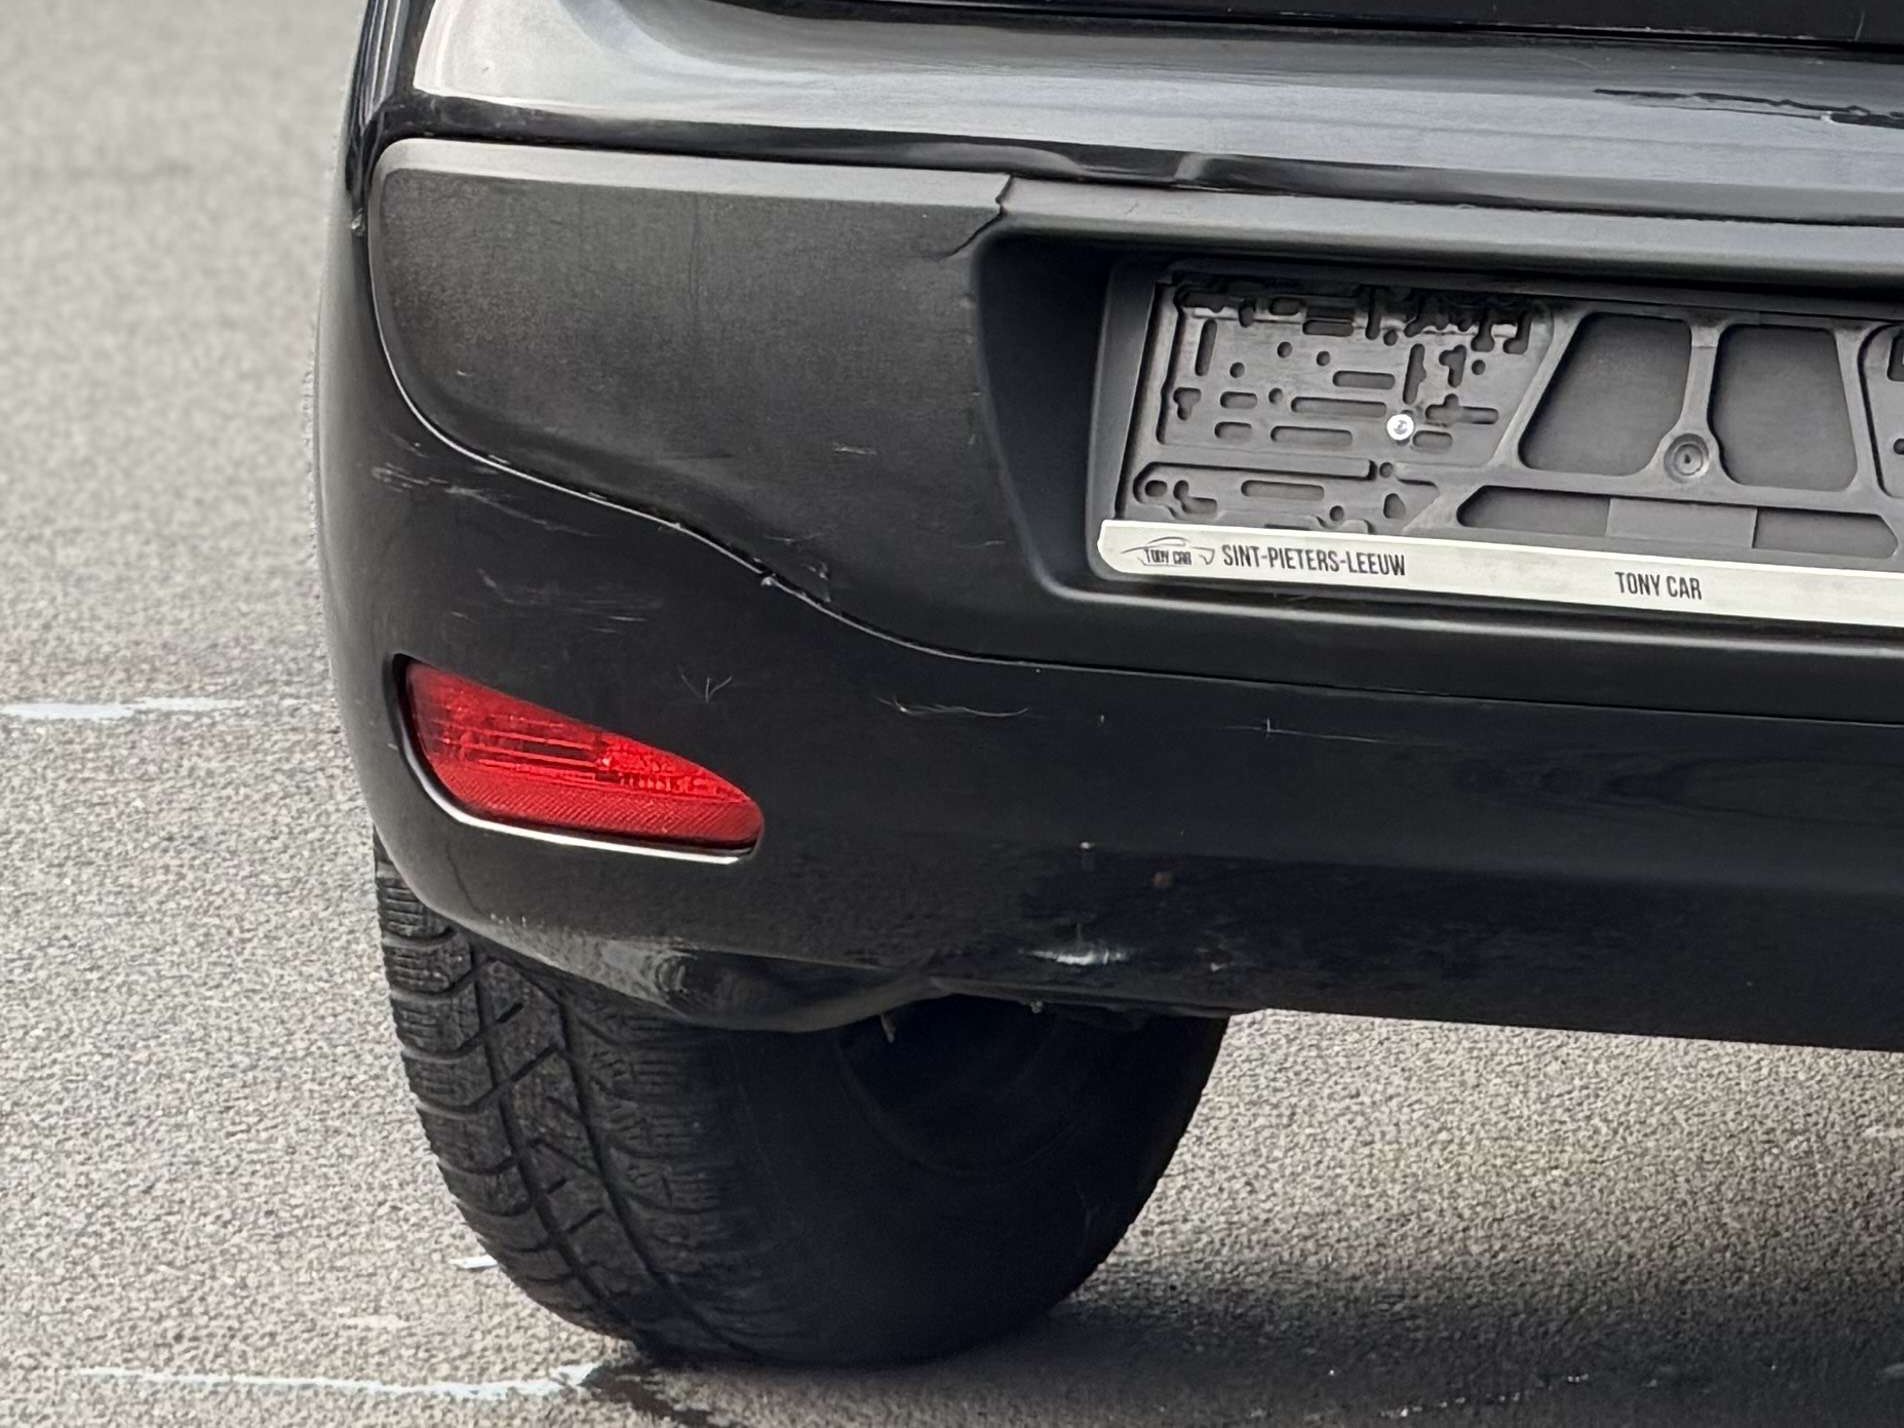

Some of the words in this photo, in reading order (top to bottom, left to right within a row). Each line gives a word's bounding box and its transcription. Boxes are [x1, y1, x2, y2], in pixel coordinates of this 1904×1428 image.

[1222, 543, 1407, 577] SINT-PIETERS-LEEUW
[1614, 571, 1661, 597] TONY
[1666, 575, 1703, 601] CAR
